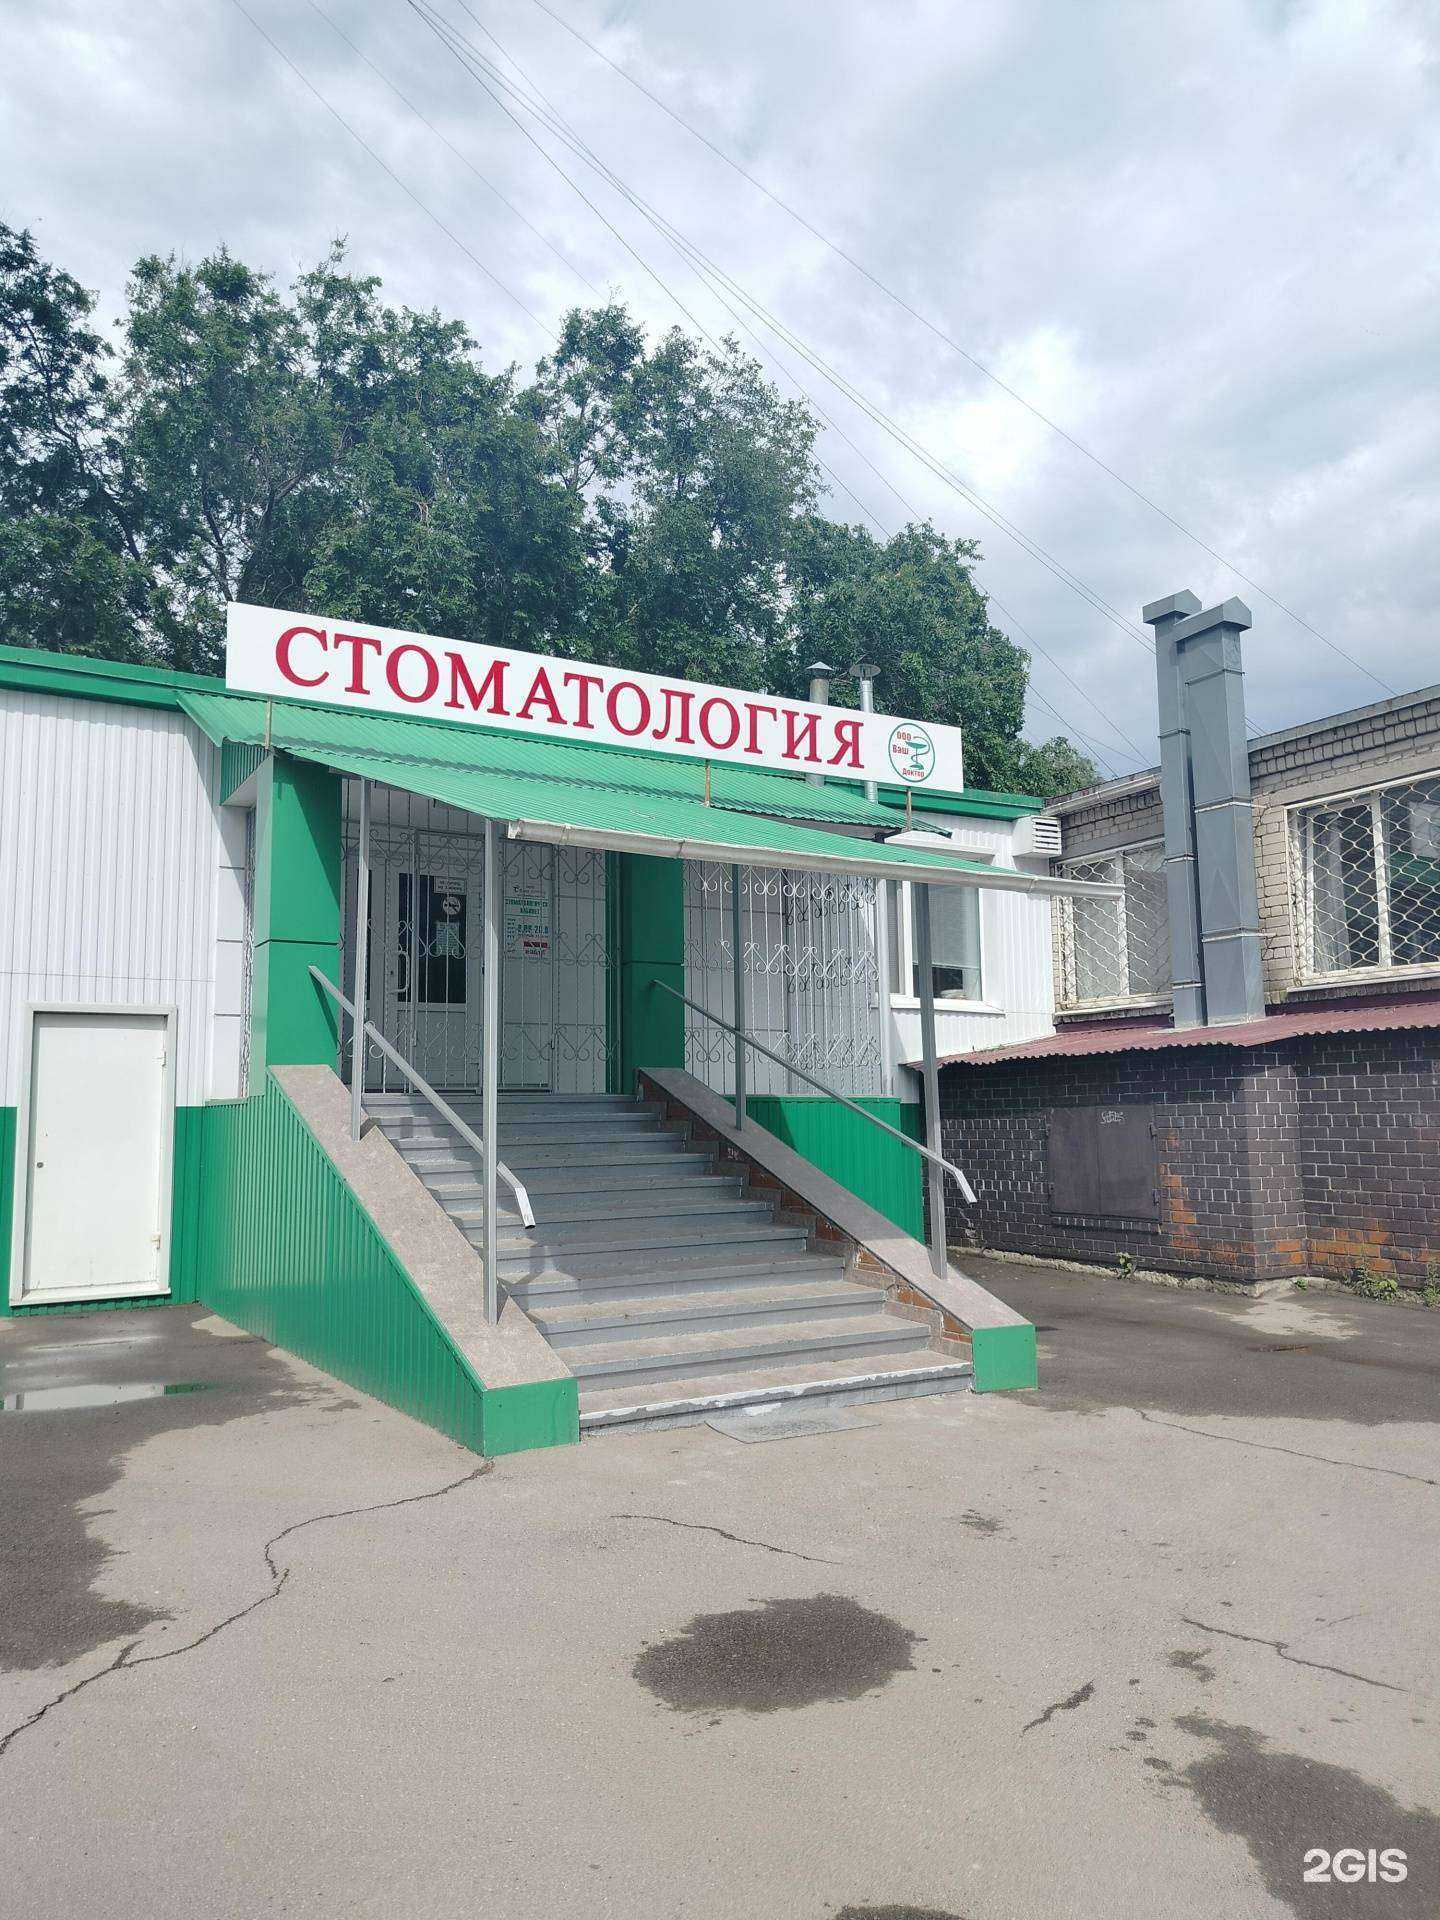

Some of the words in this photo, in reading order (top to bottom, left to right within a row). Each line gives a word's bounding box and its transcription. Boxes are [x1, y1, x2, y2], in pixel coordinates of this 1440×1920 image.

[276, 626, 865, 768] СТОМАТОЛОГИЯ
[897, 731, 912, 741] ООО
[893, 745, 909, 755] Ваш
[903, 768, 925, 778] Доктор
